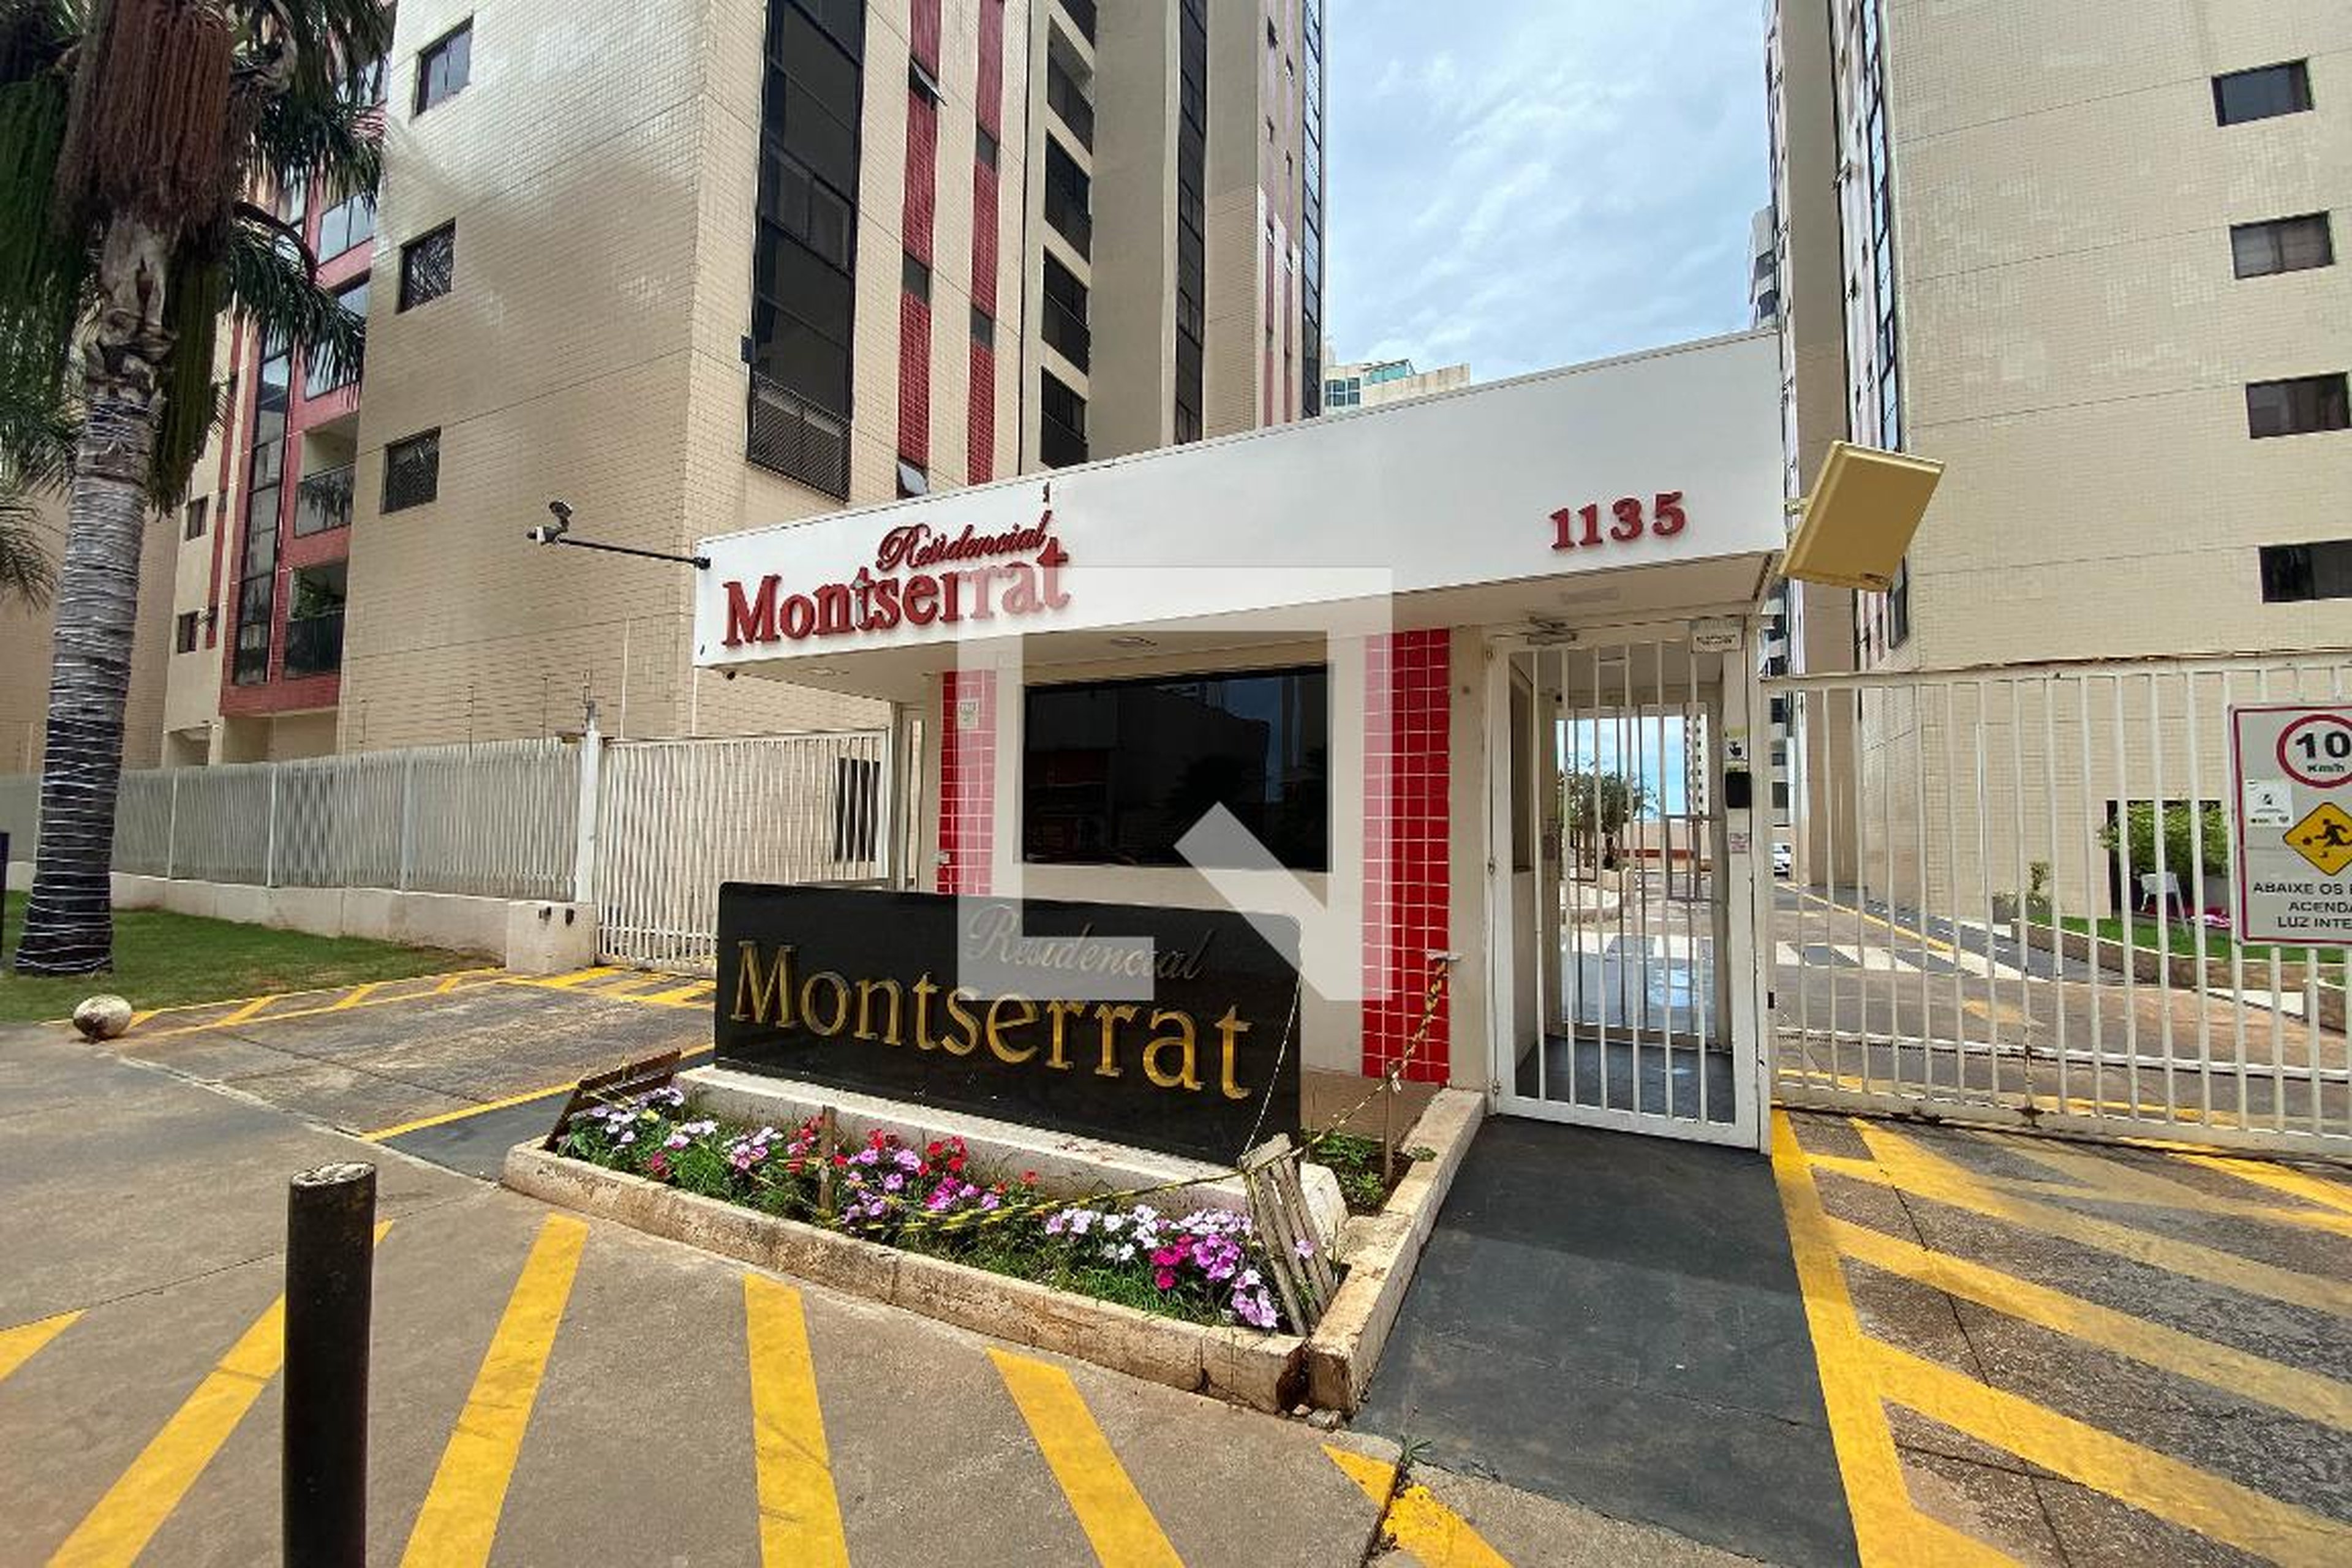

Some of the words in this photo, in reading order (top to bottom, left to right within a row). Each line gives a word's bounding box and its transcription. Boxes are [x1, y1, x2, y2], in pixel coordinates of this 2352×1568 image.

[875, 510, 1052, 571] Residencial
[1549, 491, 1686, 550] 1135
[722, 537, 1069, 647] Montserrat
[2296, 731, 2351, 758] 10
[2253, 881, 2314, 894] ABAIXE
[2319, 883, 2343, 895] OS
[965, 903, 1217, 980] Residencial
[2277, 916, 2309, 927] LUZ
[730, 940, 1252, 1100] Montserrat
